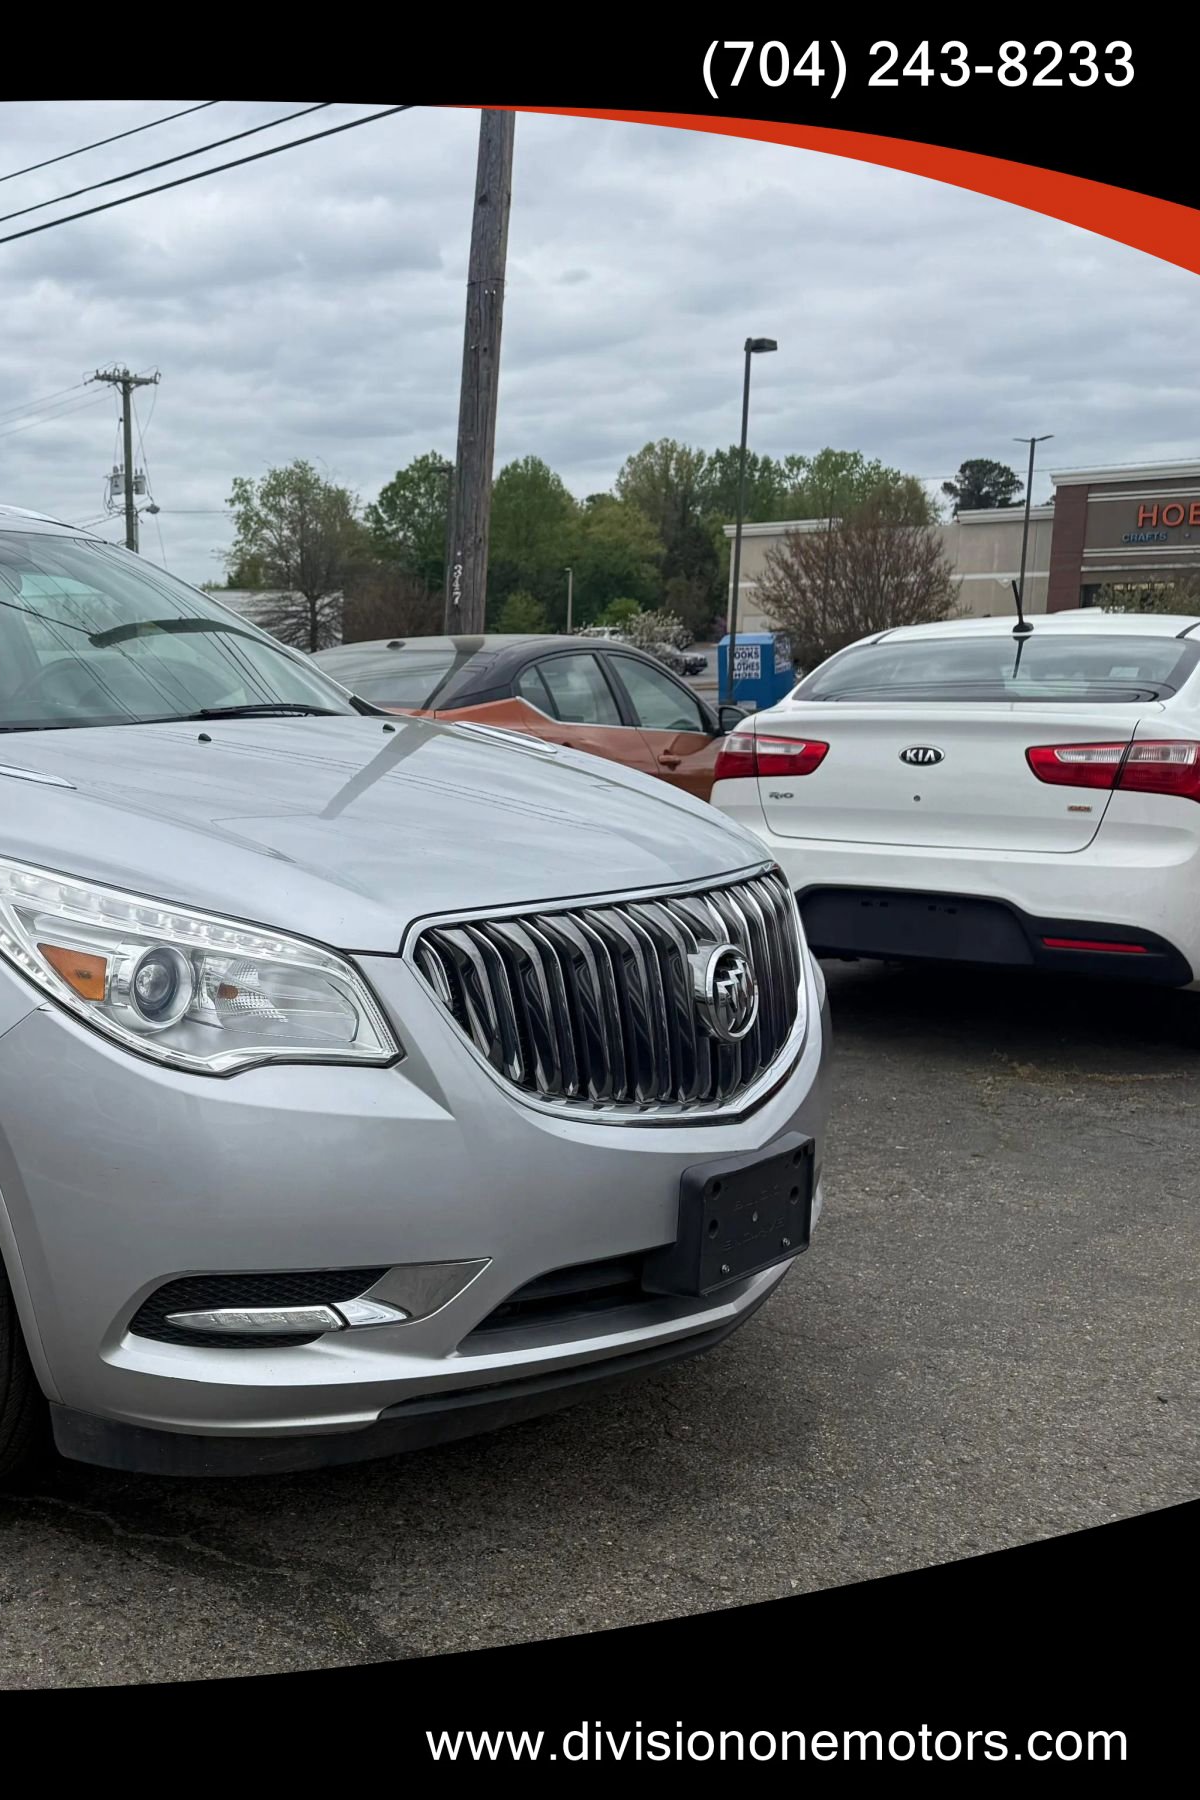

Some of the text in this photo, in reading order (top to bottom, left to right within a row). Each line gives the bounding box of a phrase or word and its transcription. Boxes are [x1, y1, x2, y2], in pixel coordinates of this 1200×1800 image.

[1122, 531, 1168, 543] CRAFTS
[734, 651, 760, 660] OOKS
[733, 661, 760, 671] OTHES
[905, 749, 936, 762] KIA
